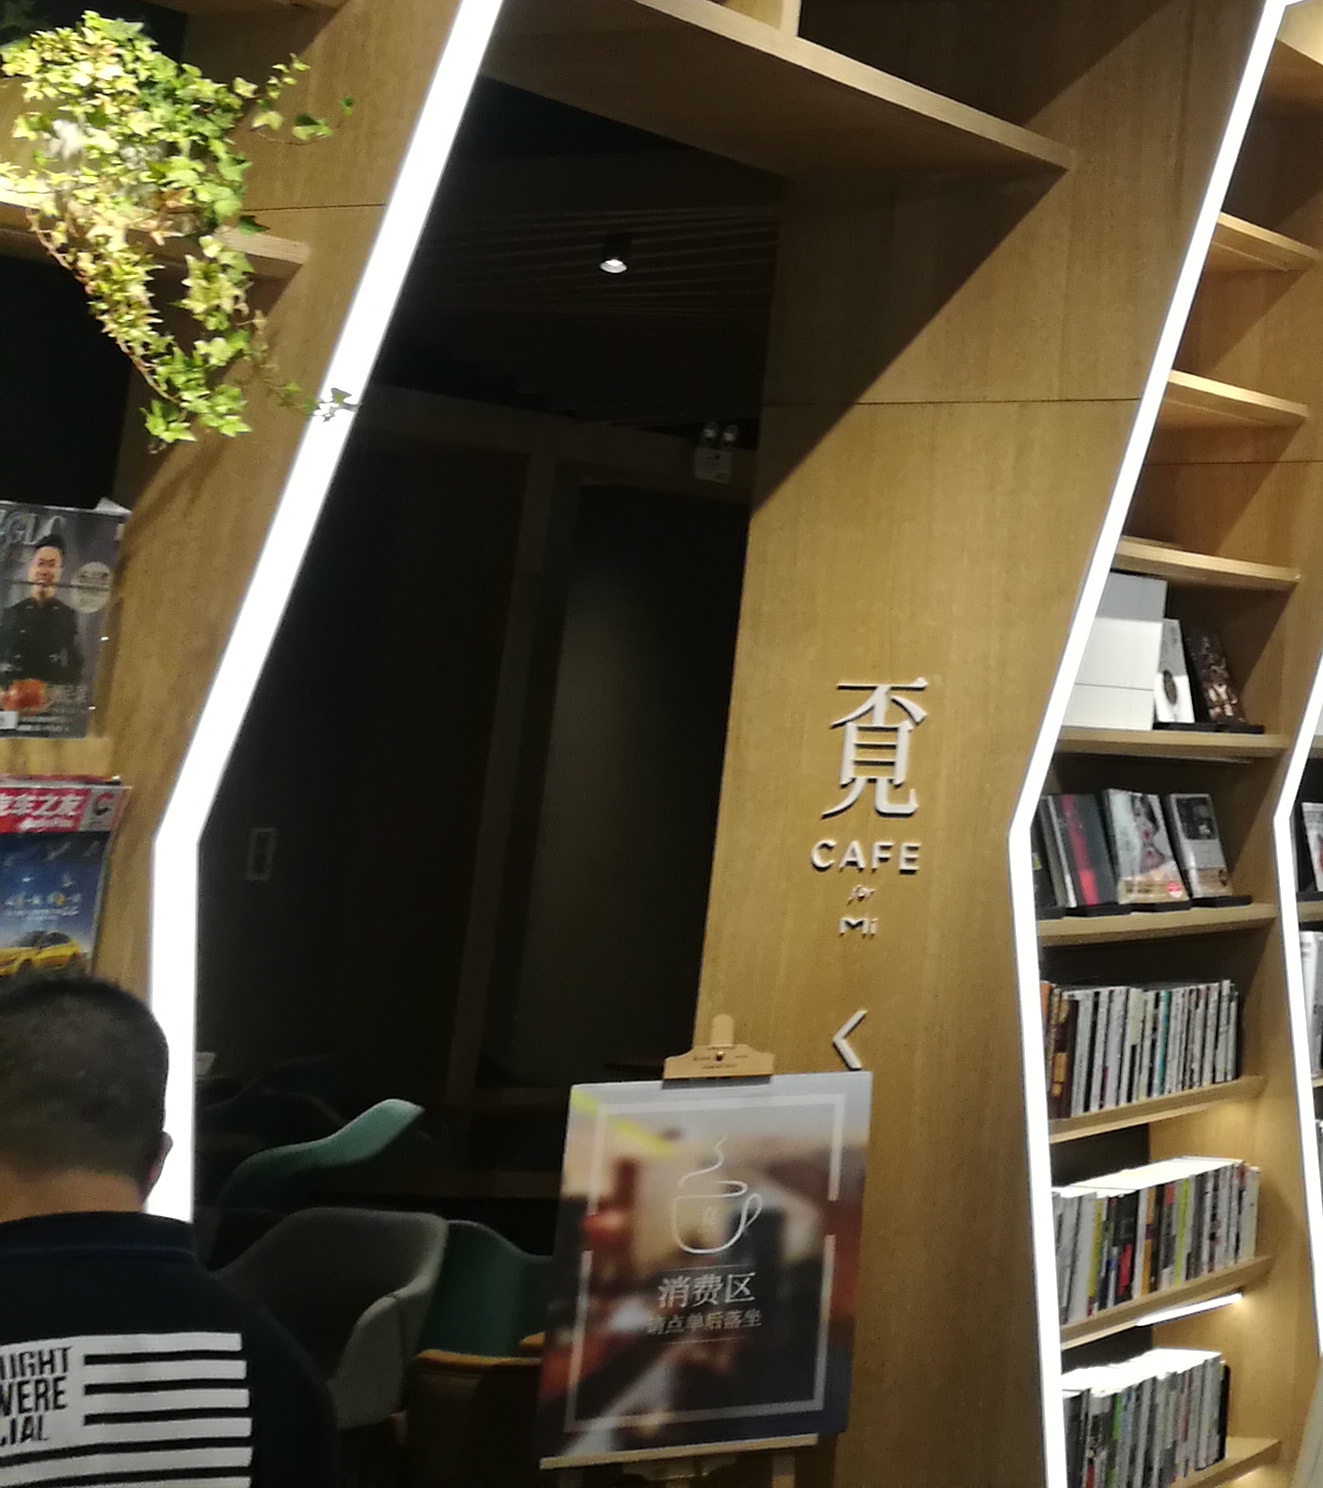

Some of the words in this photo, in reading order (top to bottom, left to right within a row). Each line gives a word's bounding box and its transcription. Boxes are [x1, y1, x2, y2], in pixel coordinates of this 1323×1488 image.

[811, 839, 922, 874] CAFE
[658, 1273, 756, 1308] 消费区
